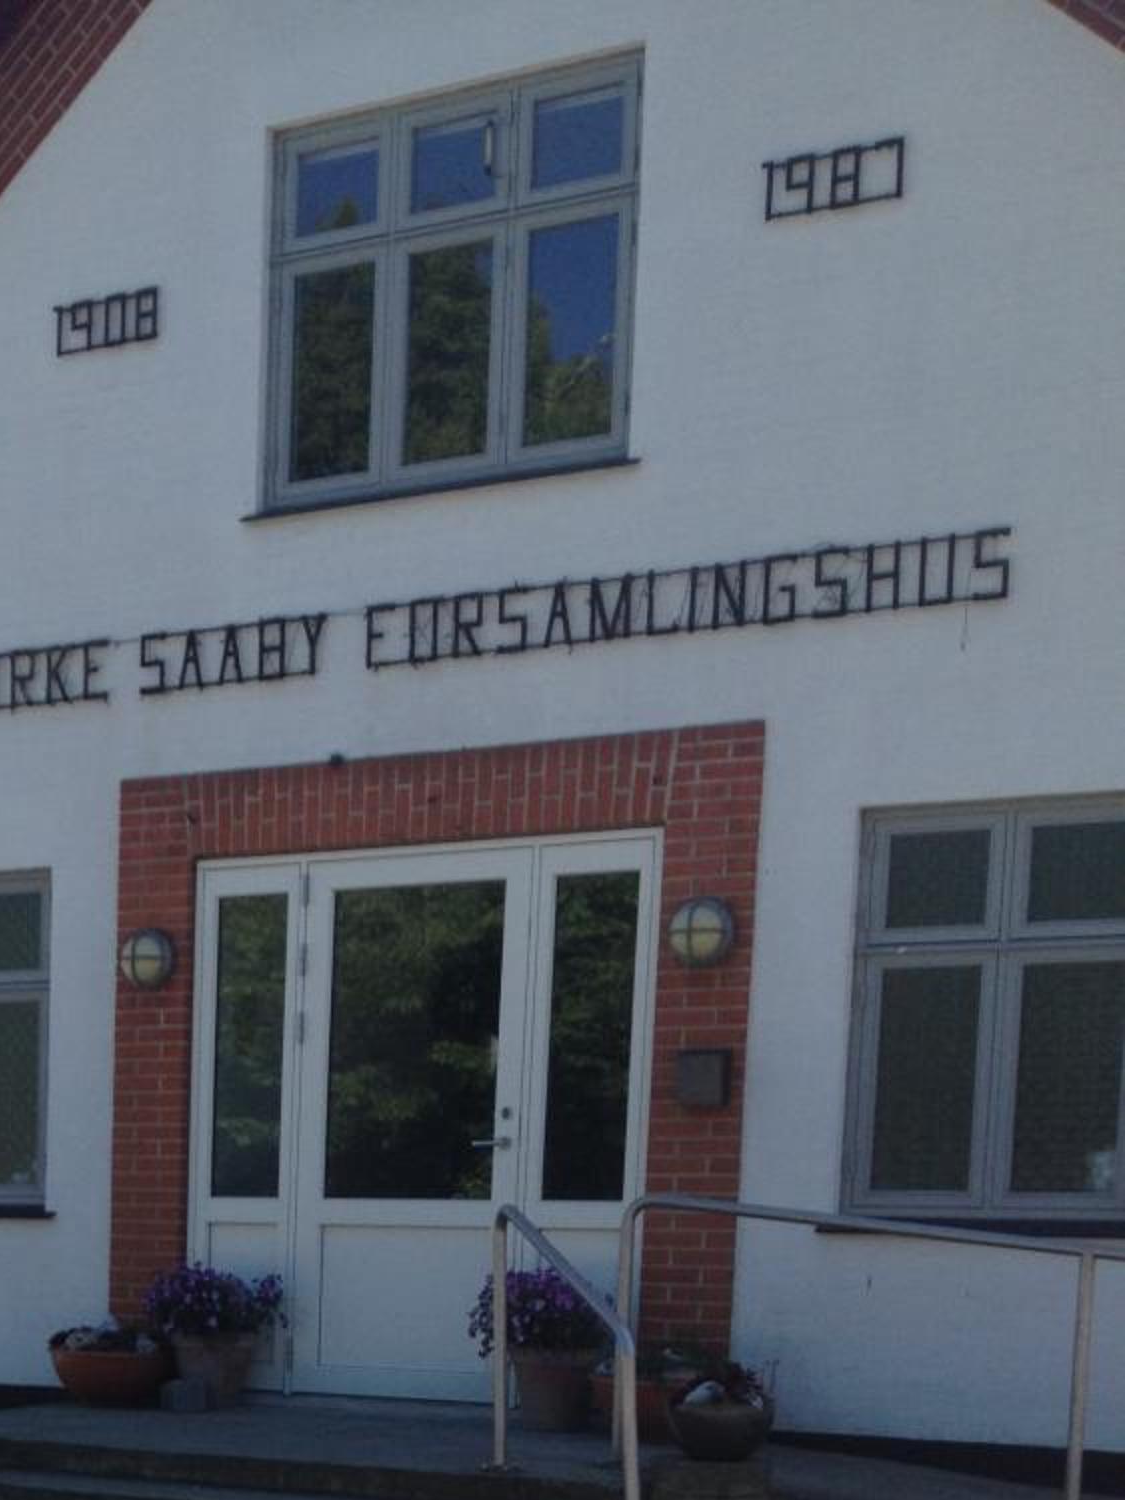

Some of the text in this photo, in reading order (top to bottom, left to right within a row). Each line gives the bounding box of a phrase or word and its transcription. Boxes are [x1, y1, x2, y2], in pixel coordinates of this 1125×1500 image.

[762, 136, 904, 221] 1987
[53, 285, 159, 357] 1908
[139, 612, 328, 696] SAABY
[366, 527, 1011, 669] FORSAMLINGSHUS
